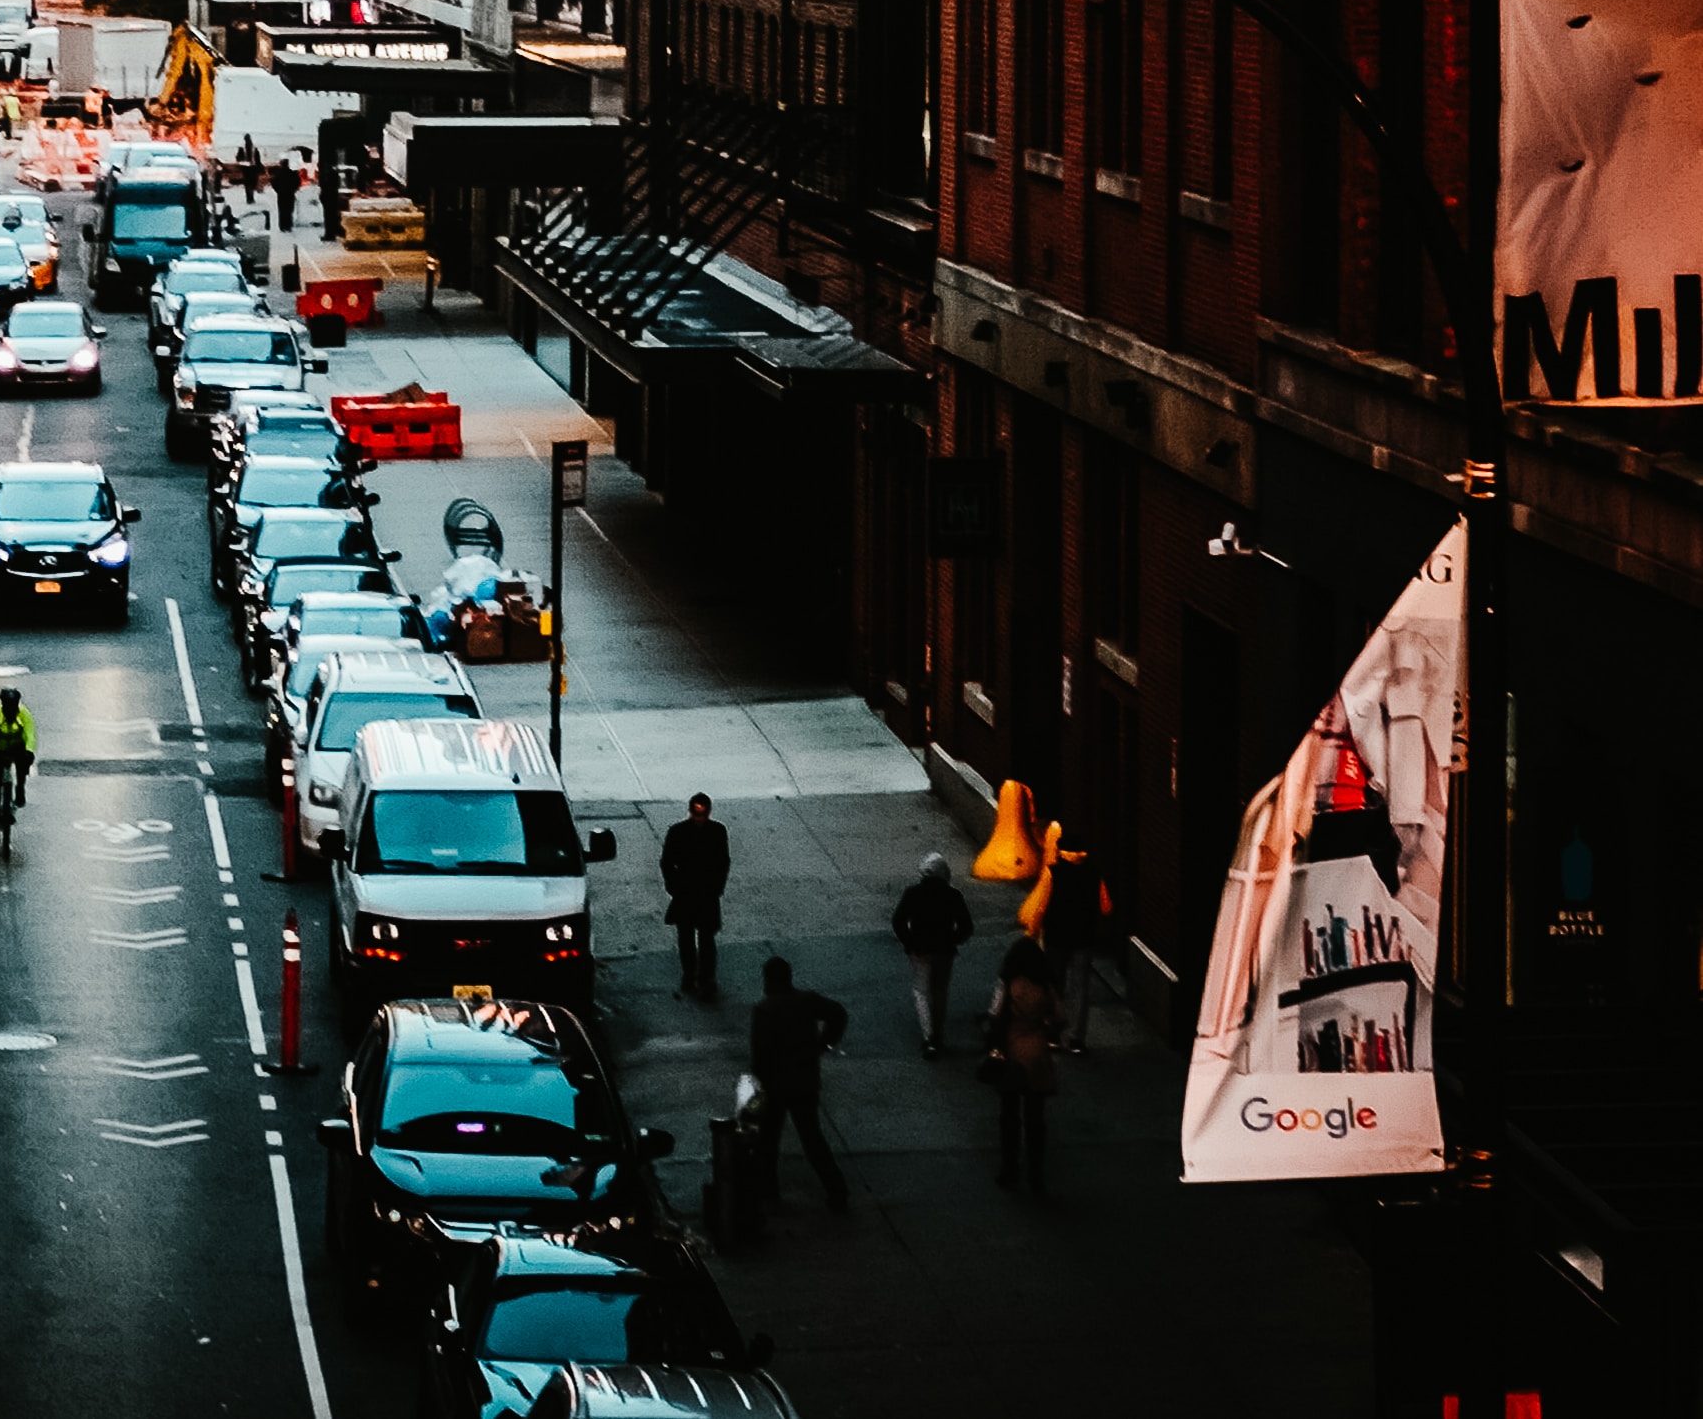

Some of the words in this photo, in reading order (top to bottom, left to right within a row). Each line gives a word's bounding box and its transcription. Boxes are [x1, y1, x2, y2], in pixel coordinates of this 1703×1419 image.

[1558, 910, 1594, 922] BLUE
[1548, 924, 1604, 936] BOTTLE
[1240, 1096, 1378, 1139] Google
